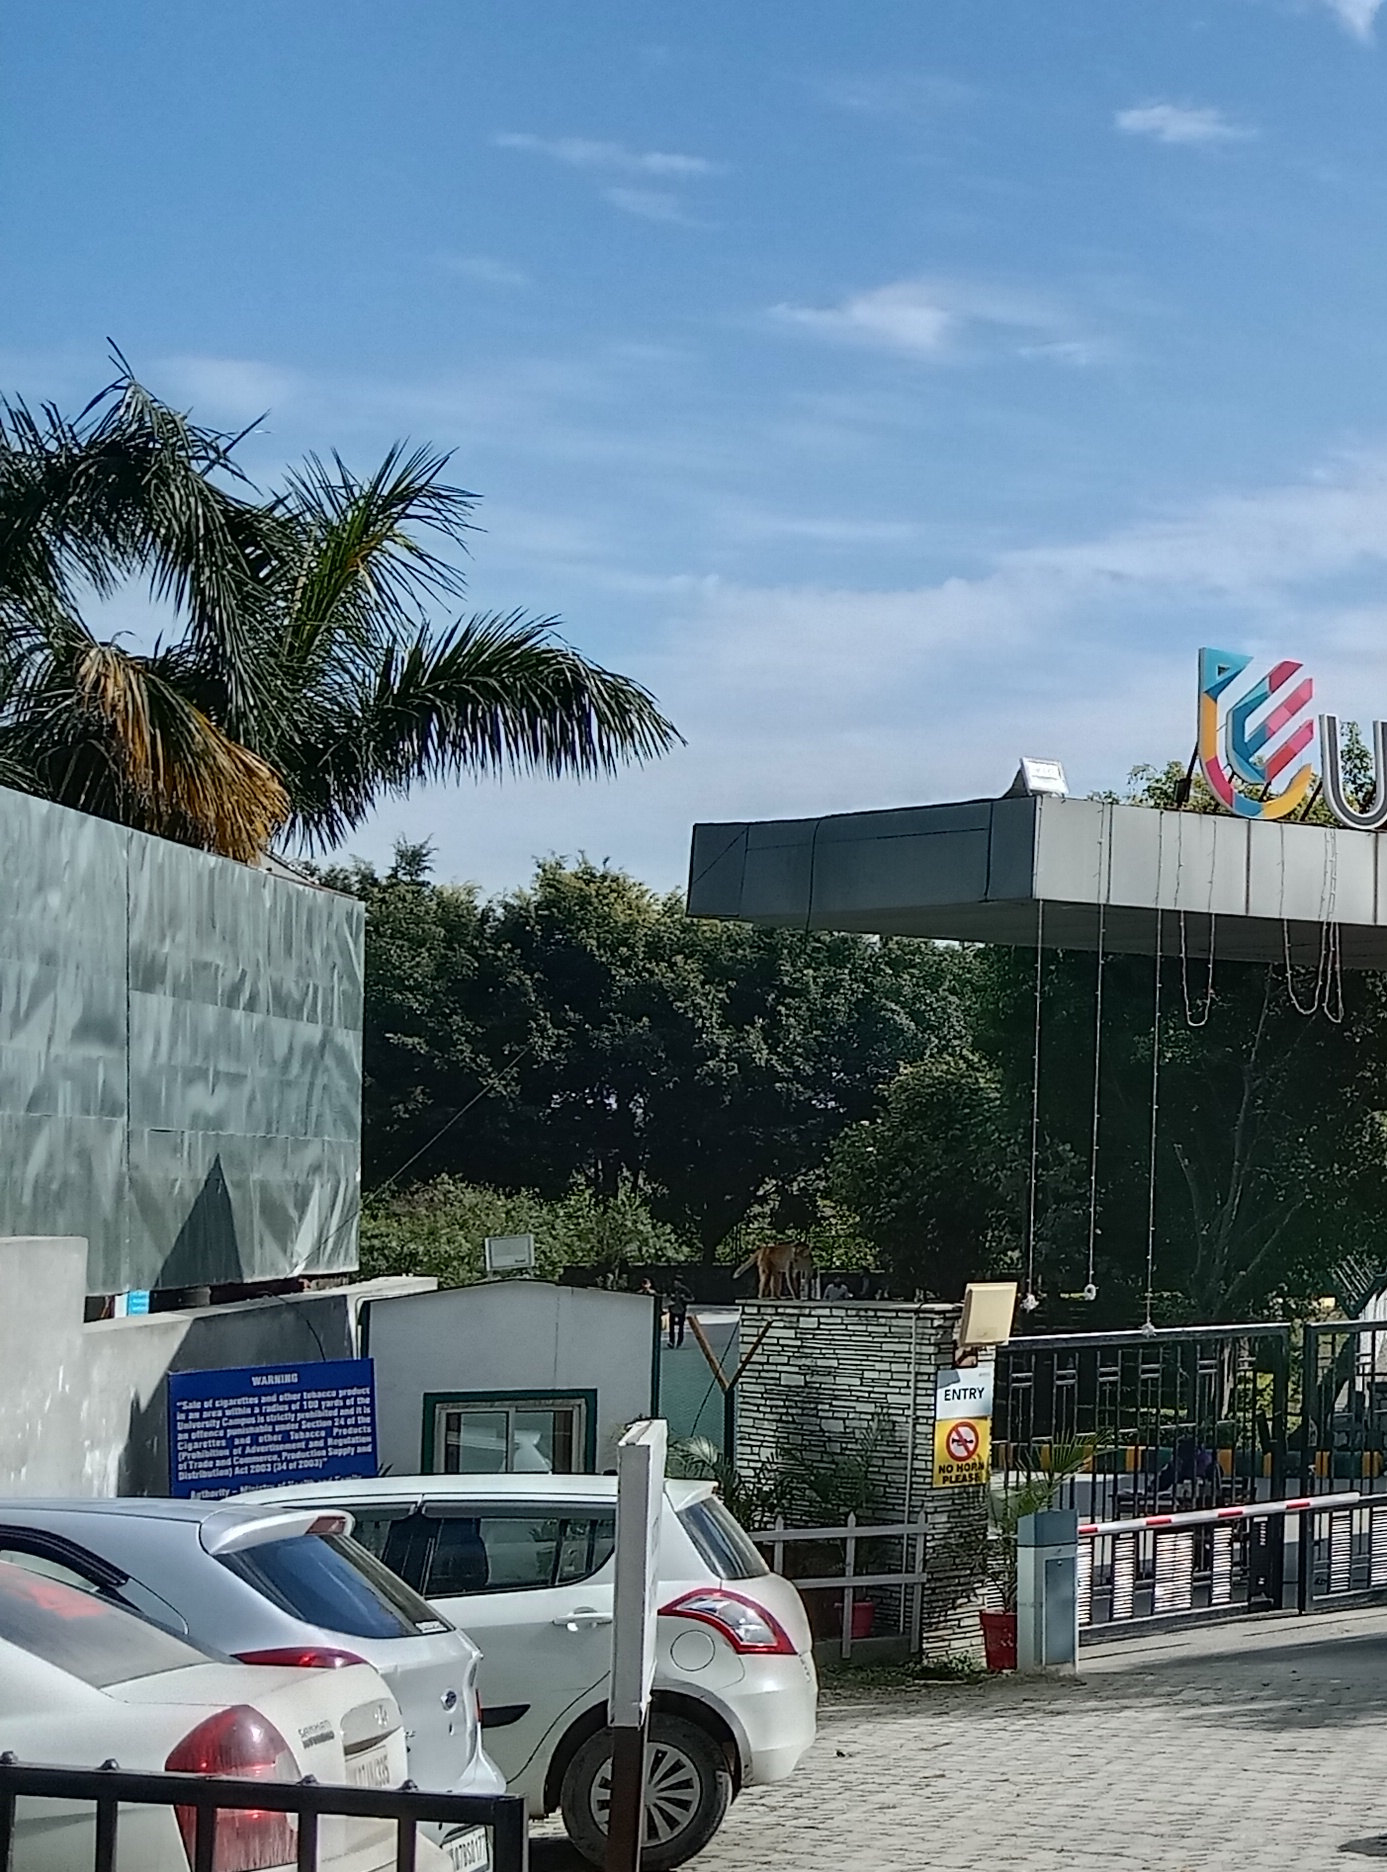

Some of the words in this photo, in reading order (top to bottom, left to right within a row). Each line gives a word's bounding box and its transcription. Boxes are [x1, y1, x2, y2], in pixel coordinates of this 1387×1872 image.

[252, 1373, 298, 1385] WARNING
[204, 1399, 213, 1407] of
[215, 1397, 258, 1408] cigarettes
[261, 1393, 277, 1403] and
[279, 1393, 301, 1401] other
[303, 1390, 336, 1399] tobacco
[339, 1387, 370, 1397] product
[944, 1387, 985, 1401] ENTRY
[177, 1412, 186, 1420] in
[203, 1410, 222, 1418] area
[225, 1407, 251, 1415] within
[262, 1404, 288, 1412] radius
[291, 1402, 300, 1410] of
[321, 1400, 343, 1409] yards
[346, 1397, 354, 1405] of
[177, 1420, 220, 1430] University
[222, 1417, 255, 1427] Campus
[257, 1415, 265, 1423] is
[266, 1413, 295, 1422] strictly
[297, 1408, 338, 1420] prohibited
[340, 1407, 354, 1415] and
[177, 1440, 226, 1451] Cigarettes
[234, 1436, 250, 1445] and
[259, 1434, 282, 1443] other
[290, 1430, 325, 1440] Tobacco
[333, 1426, 371, 1436] Products
[191, 1430, 224, 1439] offence
[227, 1424, 272, 1438] punishable
[275, 1423, 299, 1431] under
[302, 1420, 332, 1429] Section
[358, 1416, 370, 1424] the
[178, 1449, 229, 1461] (Prohibition
[233, 1447, 241, 1455] of
[245, 1441, 305, 1454] Advertisement
[308, 1439, 324, 1448] and
[327, 1436, 372, 1446] Regulation
[178, 1462, 187, 1470] of
[189, 1461, 213, 1469] Trade
[216, 1458, 231, 1466] and
[282, 1450, 326, 1460] Production
[328, 1447, 355, 1456] Supply
[357, 1444, 372, 1453] and
[178, 1468, 232, 1480] Distribution)
[234, 1466, 248, 1475] Act
[250, 1463, 271, 1473] 2003
[273, 1462, 287, 1473] (34
[289, 1460, 296, 1469] of
[938, 1463, 955, 1474] NO
[942, 1473, 981, 1485] PLEASE
